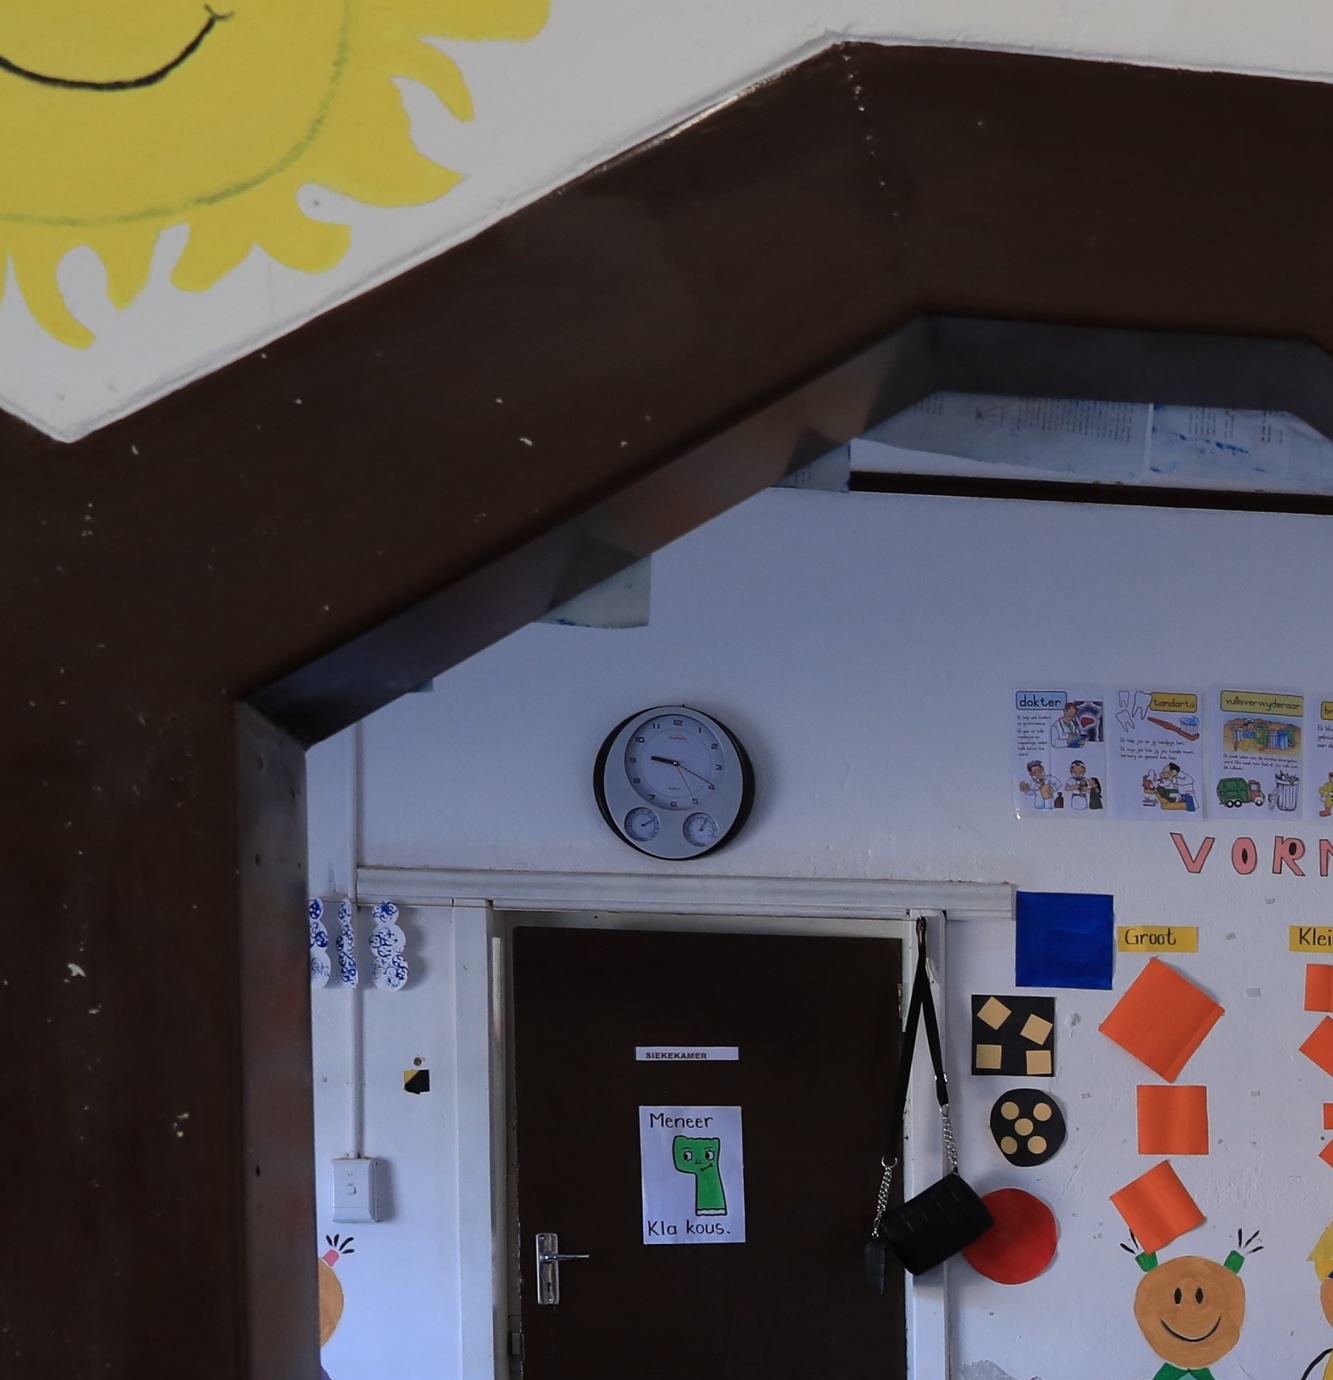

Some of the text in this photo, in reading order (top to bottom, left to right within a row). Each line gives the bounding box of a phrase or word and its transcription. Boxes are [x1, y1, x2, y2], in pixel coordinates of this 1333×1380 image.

[1020, 694, 1061, 707] dokter
[1153, 698, 1195, 708] tandarts
[1125, 928, 1176, 946] Groot
[650, 1113, 713, 1129] Meneer
[648, 1219, 731, 1236] Kla kous.
